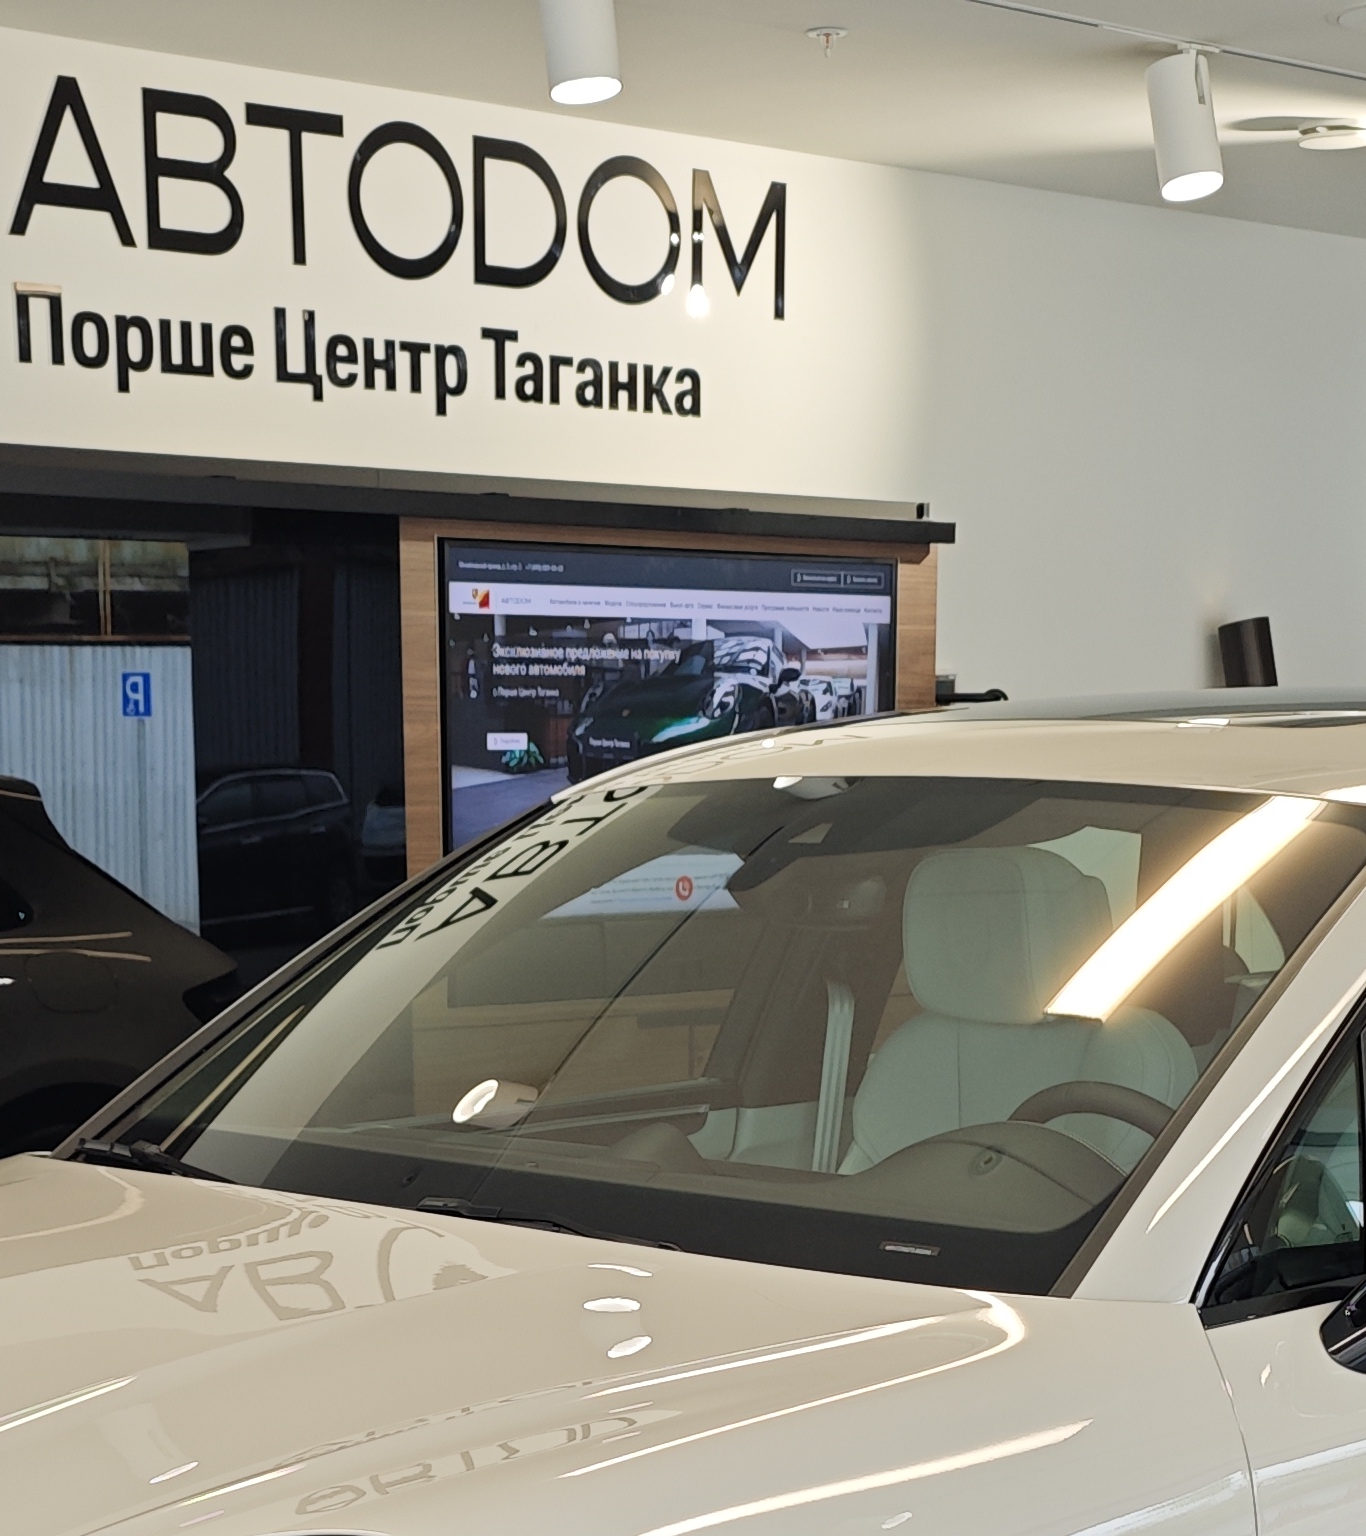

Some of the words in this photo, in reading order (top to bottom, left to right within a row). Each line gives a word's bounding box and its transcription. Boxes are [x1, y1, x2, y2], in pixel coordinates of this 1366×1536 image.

[12, 280, 255, 394] Порше
[273, 305, 469, 416] Центр
[481, 327, 703, 418] Таганка
